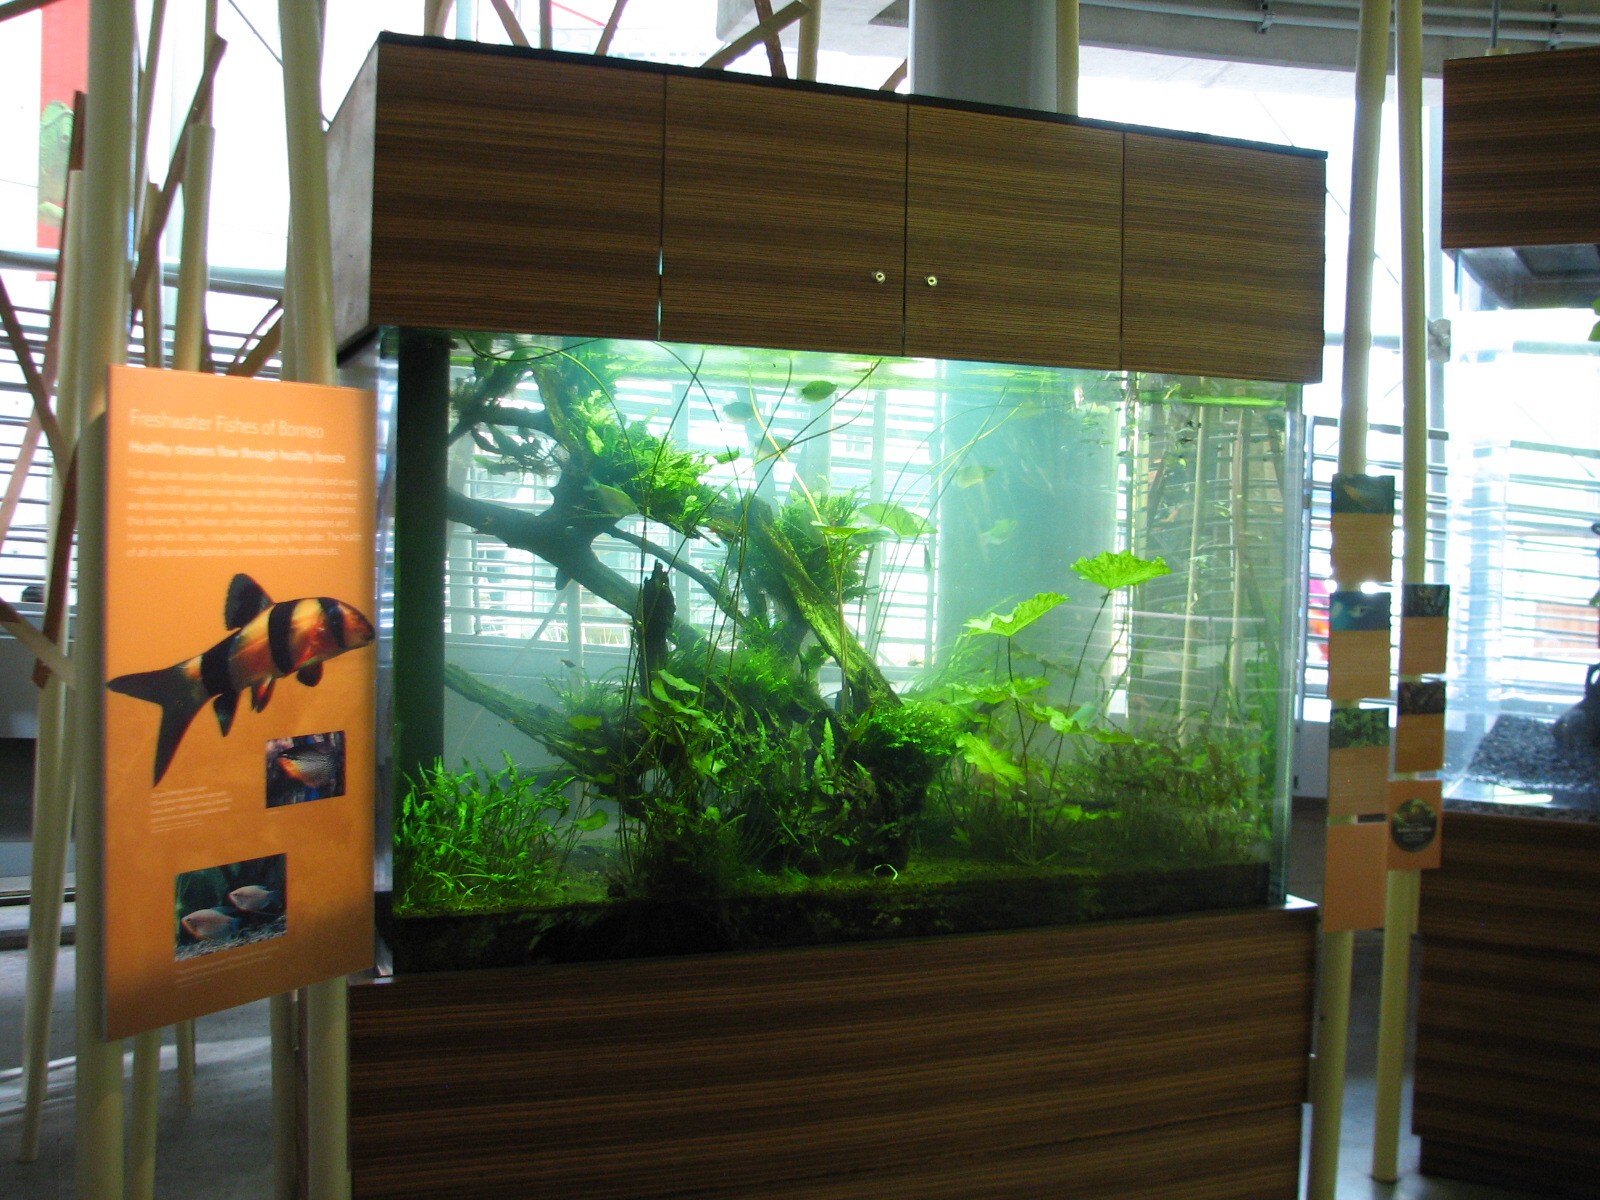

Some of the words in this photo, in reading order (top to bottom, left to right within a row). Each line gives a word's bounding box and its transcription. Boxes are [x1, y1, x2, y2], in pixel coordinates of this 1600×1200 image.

[128, 408, 212, 430] Freshwater
[215, 415, 259, 435] Fishes
[261, 418, 276, 436] of
[278, 419, 325, 439] Borneo
[128, 440, 172, 457] Healthy
[175, 445, 215, 457] streams
[217, 445, 239, 458] flow
[240, 447, 277, 462] through
[279, 449, 313, 464] healthy
[315, 451, 345, 463] forests
